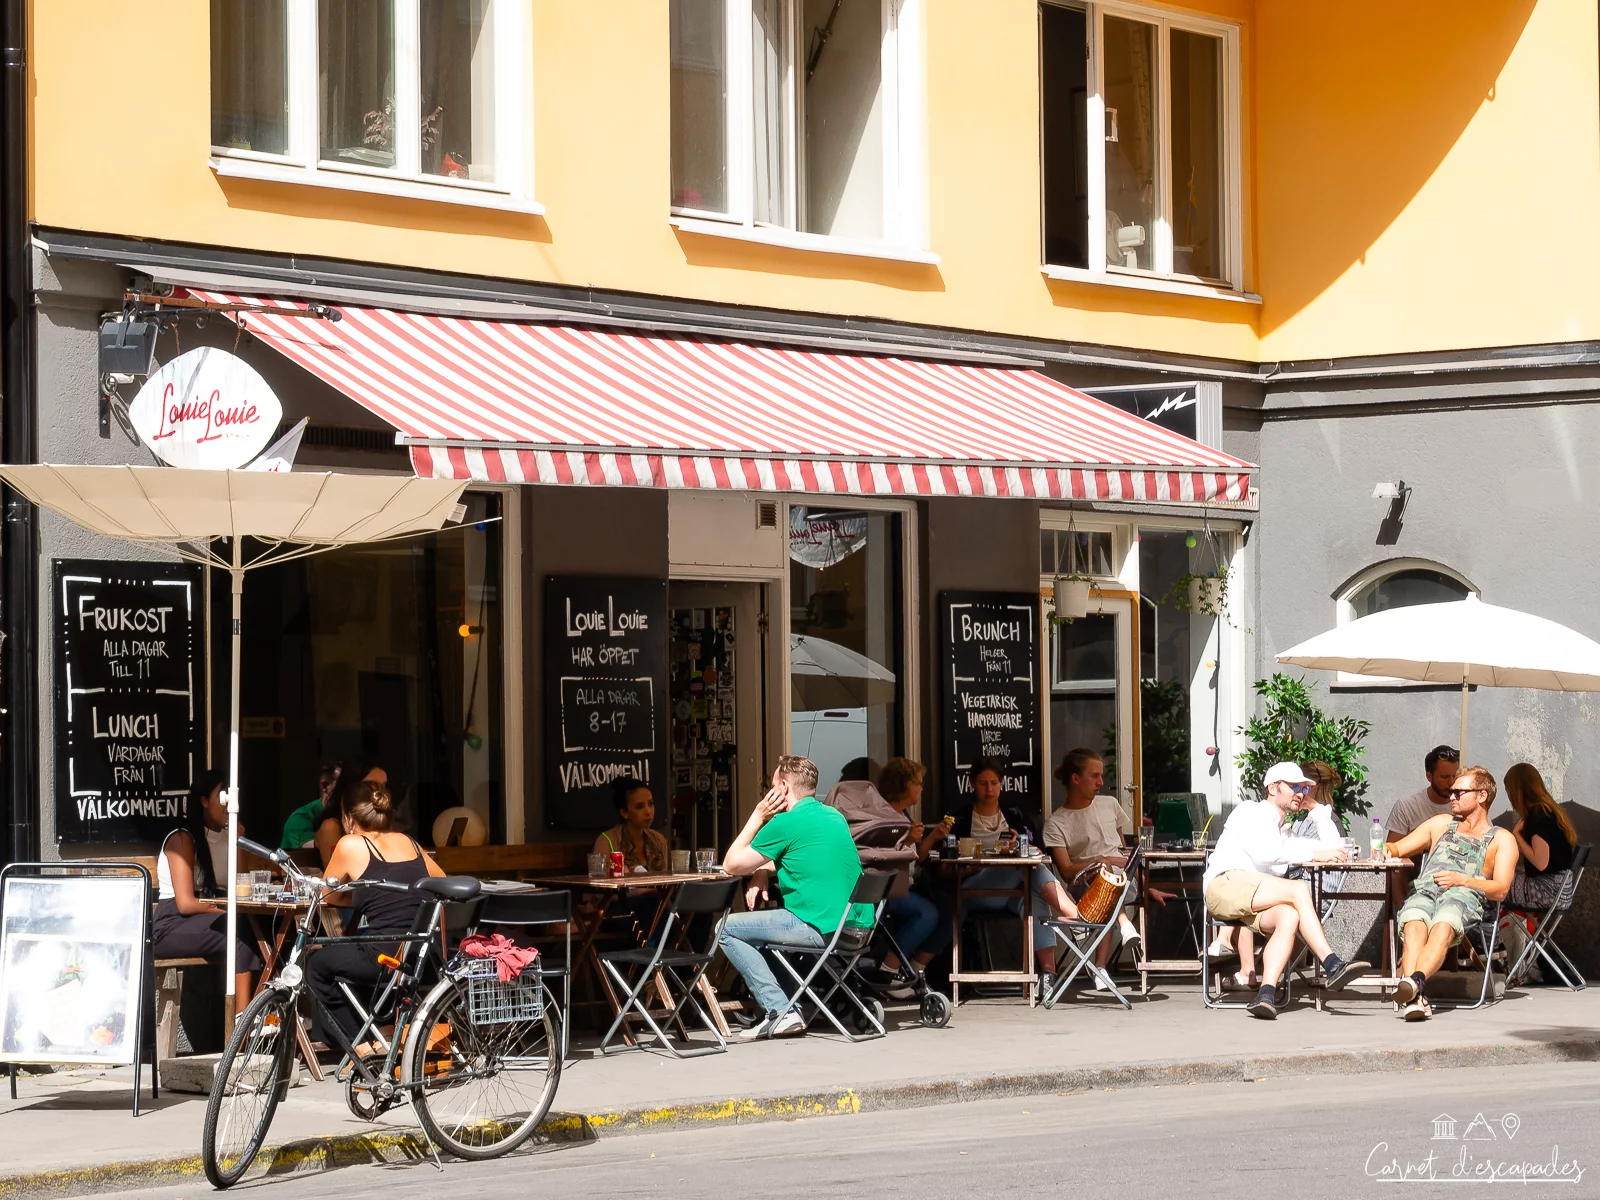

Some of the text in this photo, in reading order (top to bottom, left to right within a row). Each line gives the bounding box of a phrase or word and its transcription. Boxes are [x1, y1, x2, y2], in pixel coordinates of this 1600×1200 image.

[153, 383, 260, 444] Louie Louie
[79, 595, 173, 633] FRUKOST
[961, 614, 1019, 642] BRUNCH
[103, 639, 169, 658] ALLA DAGAR
[571, 643, 640, 667] HAR ÖPPET
[979, 645, 1008, 661] HELGER
[108, 658, 150, 679] TILL 11
[986, 659, 1012, 674] FRÅN 11
[576, 688, 640, 706] ALLA DAGAR
[961, 692, 1019, 711] VEGETARISK
[92, 706, 159, 739] LUNCH
[589, 710, 627, 733] 8-17
[967, 711, 1023, 729] HAMBURGARE
[980, 729, 1002, 743] VARJE
[107, 743, 166, 764] VARDAGAR
[982, 743, 1011, 757] MÅNDAG
[114, 765, 144, 786] FRÅN
[559, 759, 650, 793] VÄLKOMMEN!
[957, 771, 1028, 794] VÄMEN!
[77, 796, 188, 820] VÄLKOMMEN!
